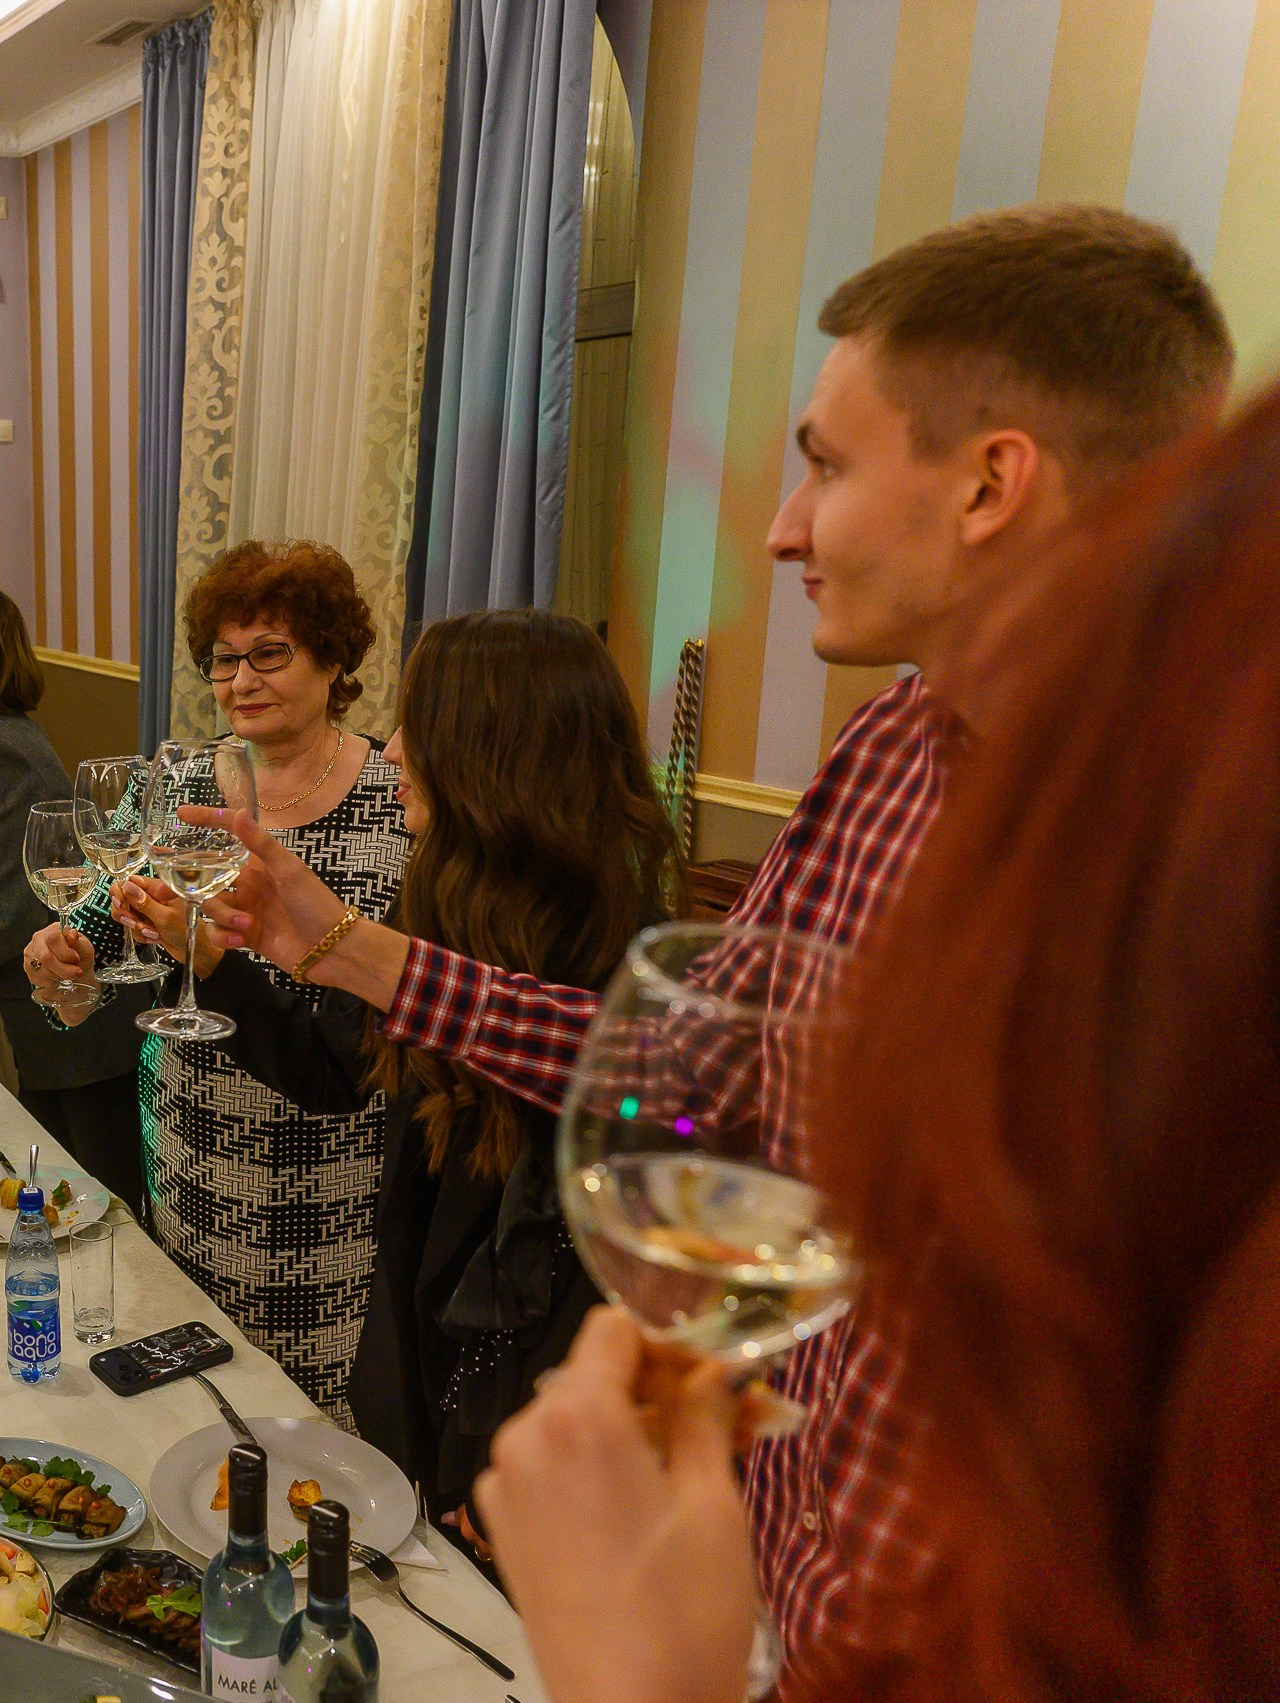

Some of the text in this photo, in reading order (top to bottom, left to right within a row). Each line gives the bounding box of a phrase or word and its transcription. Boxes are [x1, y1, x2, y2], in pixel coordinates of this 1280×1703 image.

[14, 1329, 56, 1346] bona
[14, 1343, 57, 1361] aqua
[218, 1674, 278, 1694] MARÉ AL
